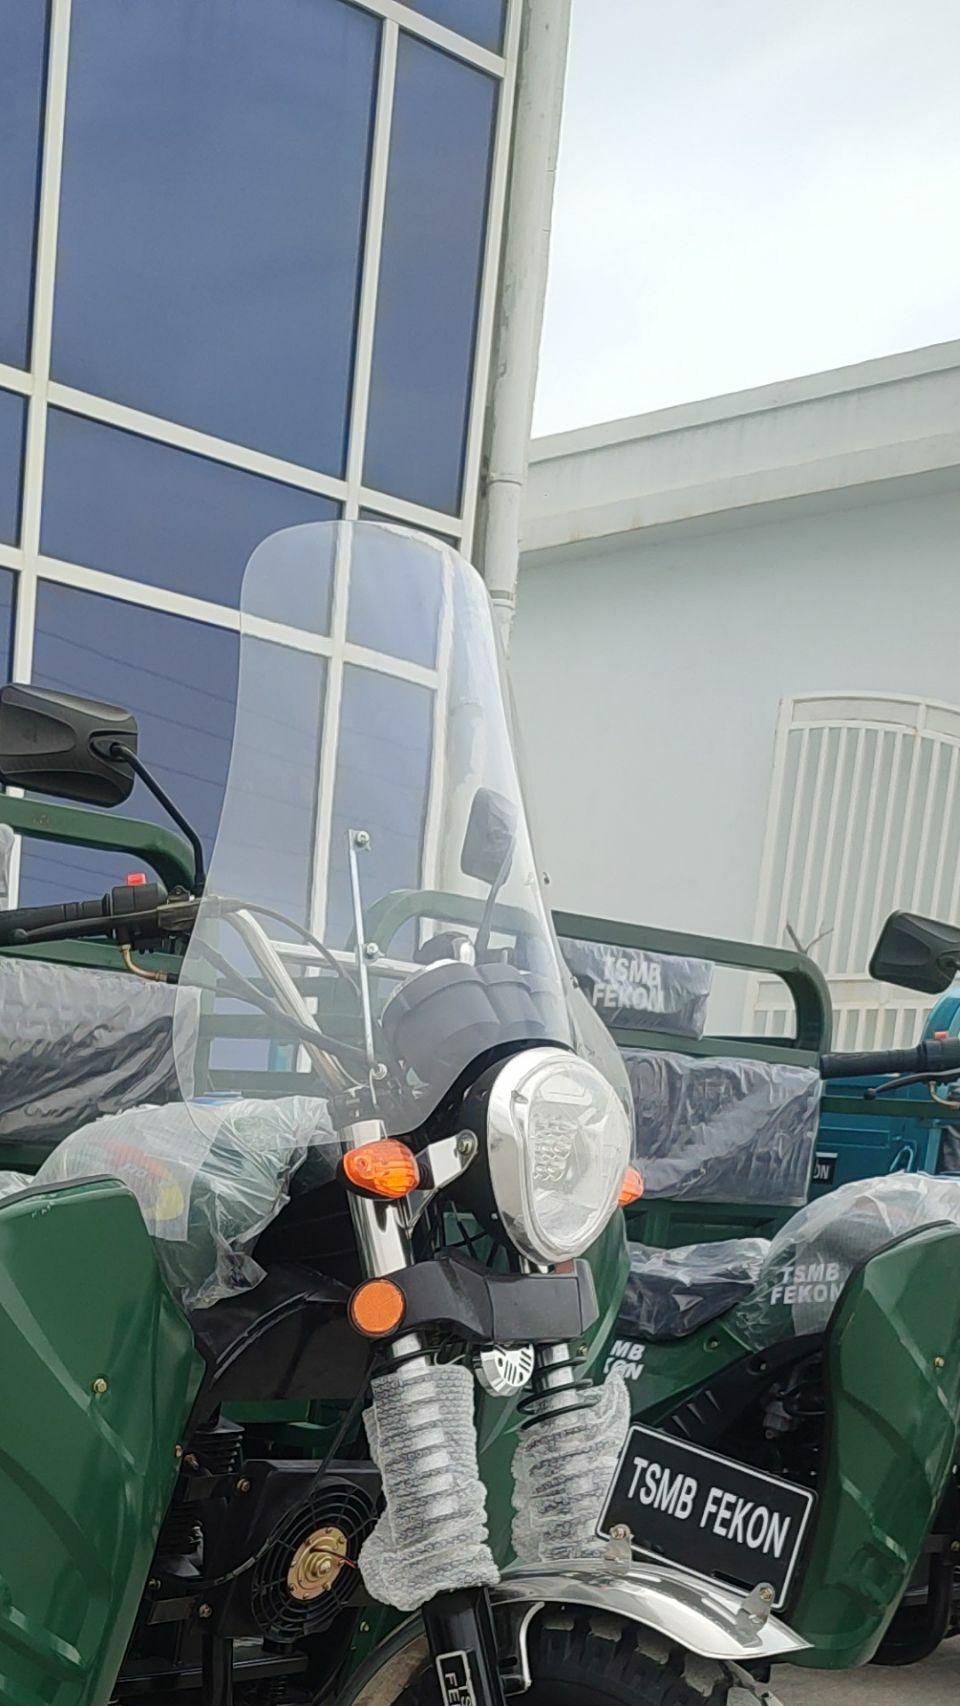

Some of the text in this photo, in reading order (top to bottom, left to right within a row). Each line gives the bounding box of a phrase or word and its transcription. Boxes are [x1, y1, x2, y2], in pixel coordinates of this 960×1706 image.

[603, 956, 662, 986] TSMB
[592, 982, 665, 1014] FEKON
[778, 1262, 840, 1284] TSMB
[627, 1456, 791, 1559] TSMB FEKON
